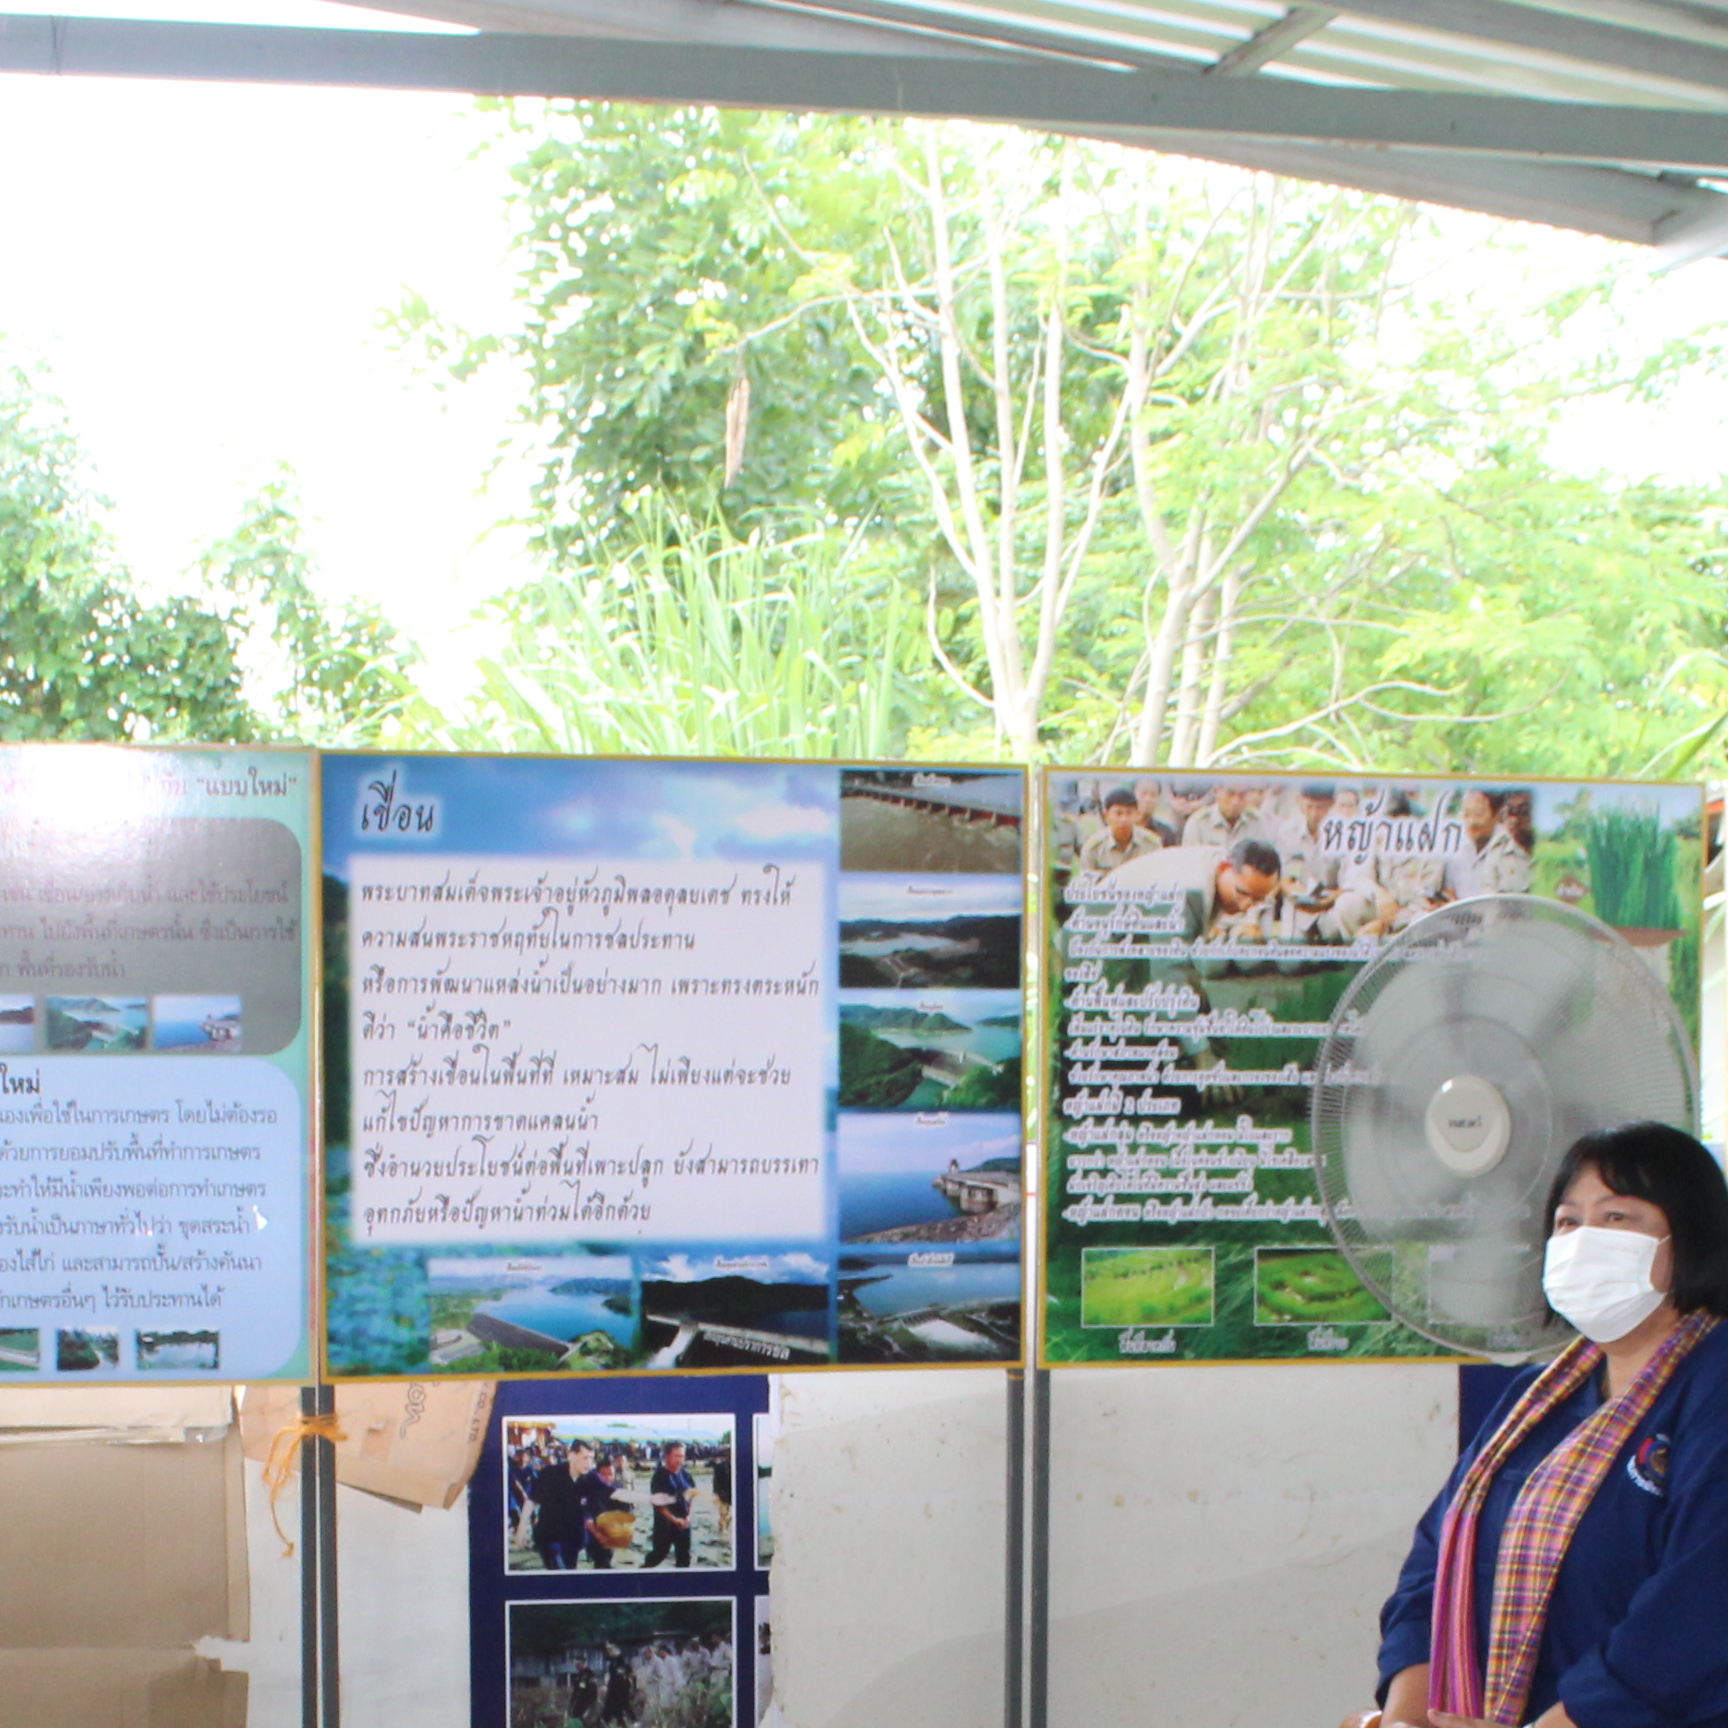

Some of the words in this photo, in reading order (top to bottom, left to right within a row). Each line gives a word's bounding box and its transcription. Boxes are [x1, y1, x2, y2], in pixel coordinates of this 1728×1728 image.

[361, 769, 434, 832] เขื่อน
[1324, 789, 1462, 864] หญ้าแฝก
[741, 863, 797, 906] ทรงให้
[361, 954, 663, 996] หรือการพัฒนาแหล่งน้ำเป็นอย่างมาก
[671, 959, 820, 996] เพราะทรงตระหนัก
[362, 1010, 396, 1040] ดีว่า
[563, 1053, 639, 1086] เหมาะสม
[640, 1042, 792, 1086] ไม่เพียงแต่จะช่วย
[362, 1089, 599, 1139] แก้ไขปัญหาการขาดแคลนน้ำ
[673, 1138, 820, 1176] ยังสามารถบรรเทา
[363, 1180, 652, 1236] อุทกภัยหรือปัญหาน้ำท่วมได้อีกด้วย
